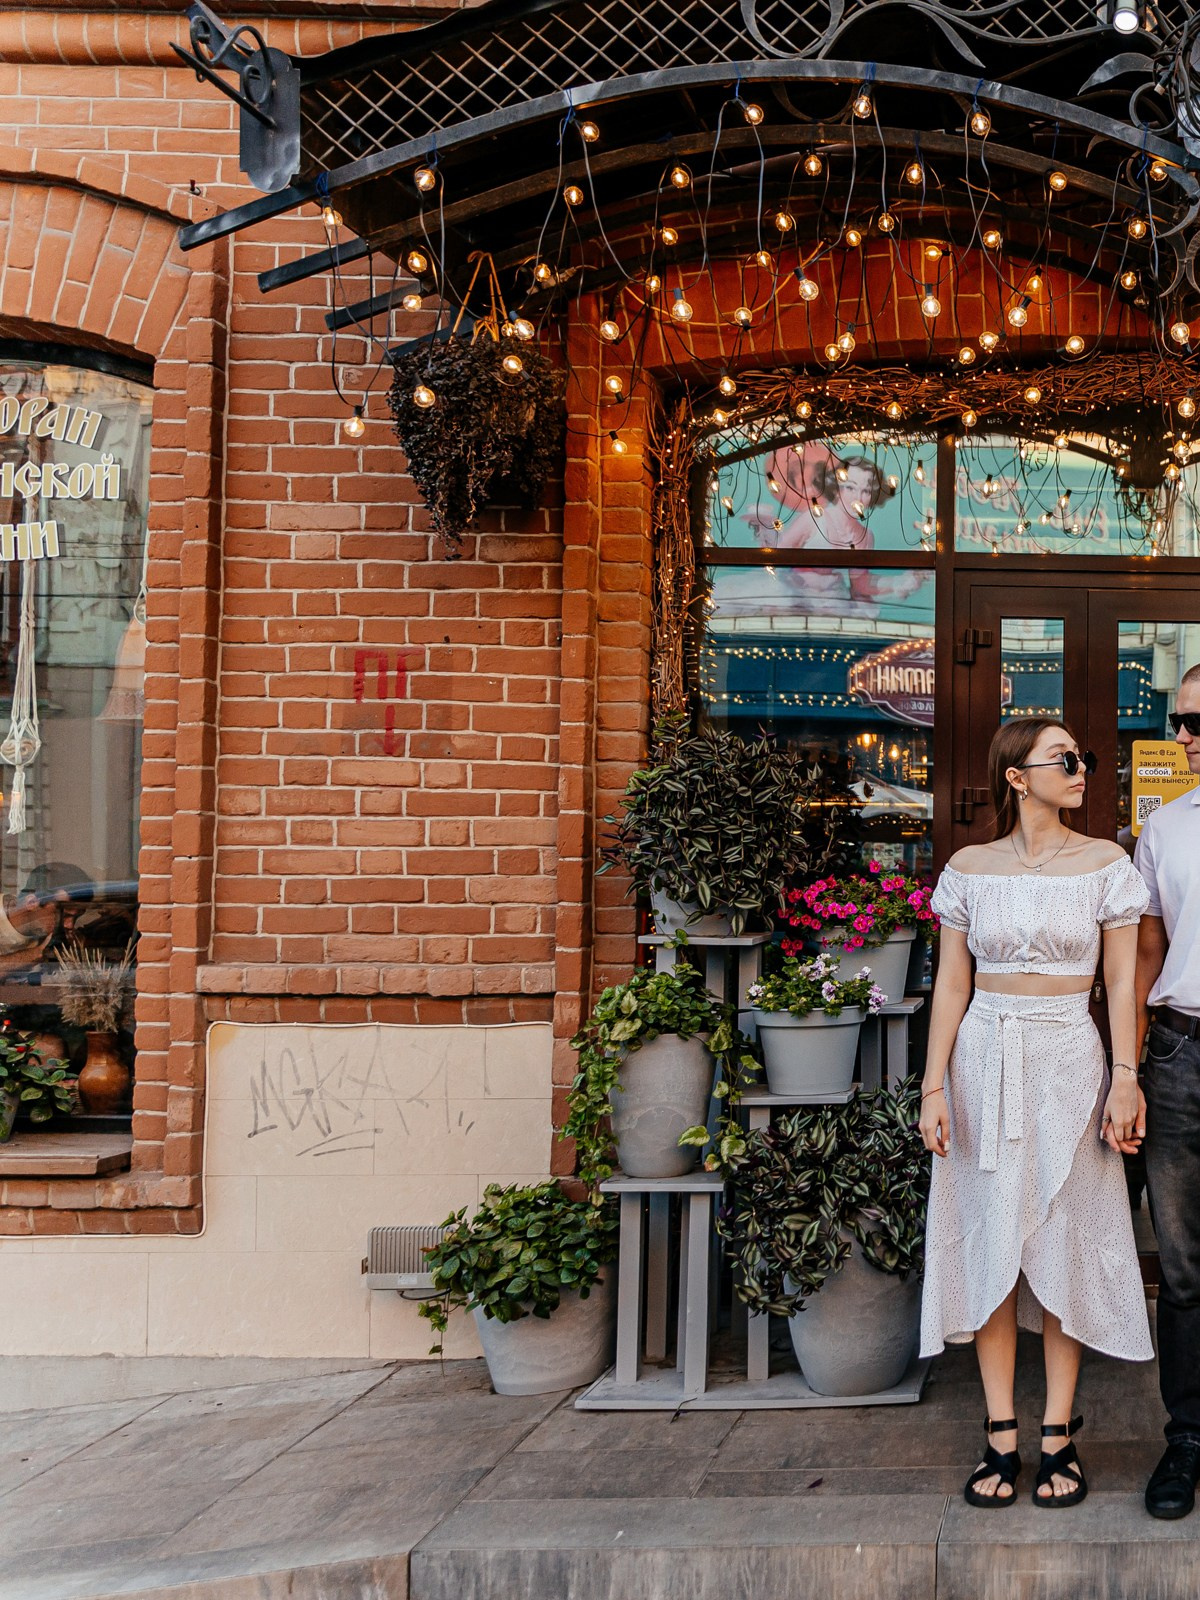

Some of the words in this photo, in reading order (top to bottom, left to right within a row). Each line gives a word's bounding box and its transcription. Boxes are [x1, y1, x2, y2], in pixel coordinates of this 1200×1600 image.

[0, 520, 60, 561] НИ
[1145, 767, 1171, 776] собой,
[1162, 777, 1194, 785] вынесут
